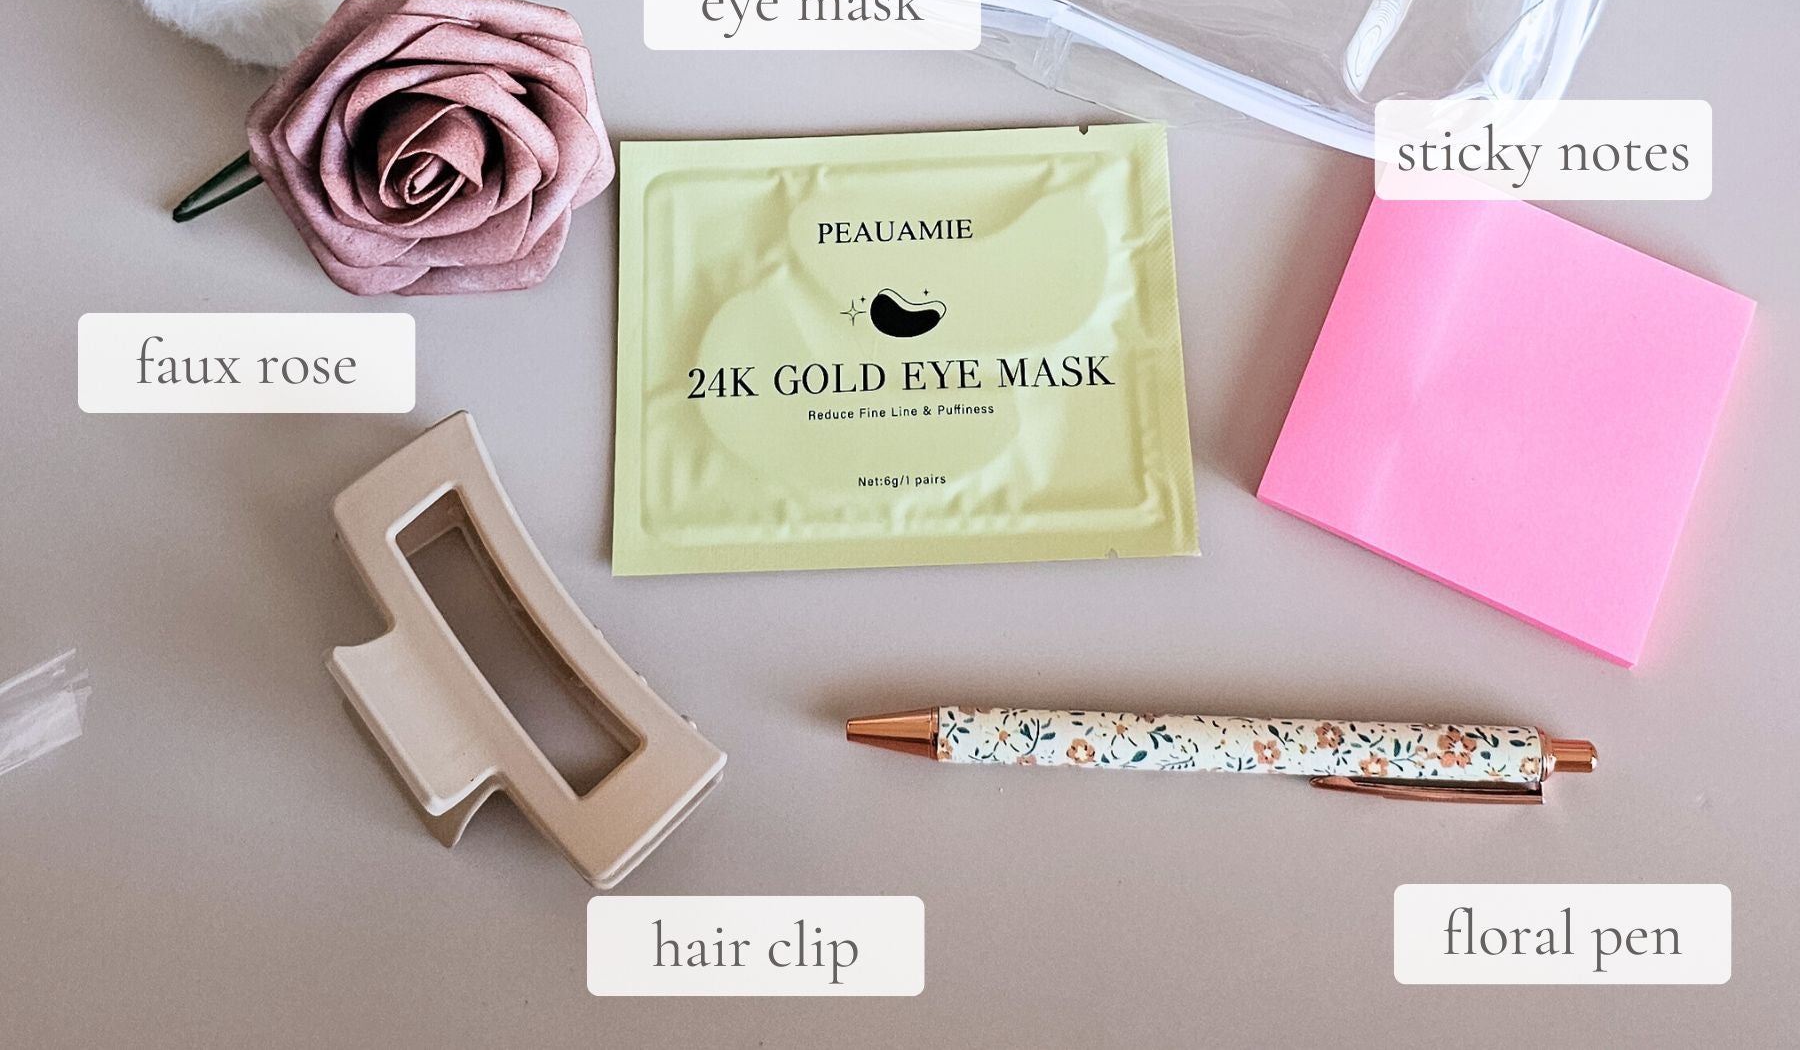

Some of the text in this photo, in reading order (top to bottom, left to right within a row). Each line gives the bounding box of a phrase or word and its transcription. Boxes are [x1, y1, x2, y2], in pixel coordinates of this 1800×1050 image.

[818, 219, 973, 245] PEAUAMIE
[687, 355, 1116, 399] 24K GOLD EYE MASK
[808, 403, 995, 421] Reduce Fine Line & Puffiness
[915, 475, 946, 487] pairs
